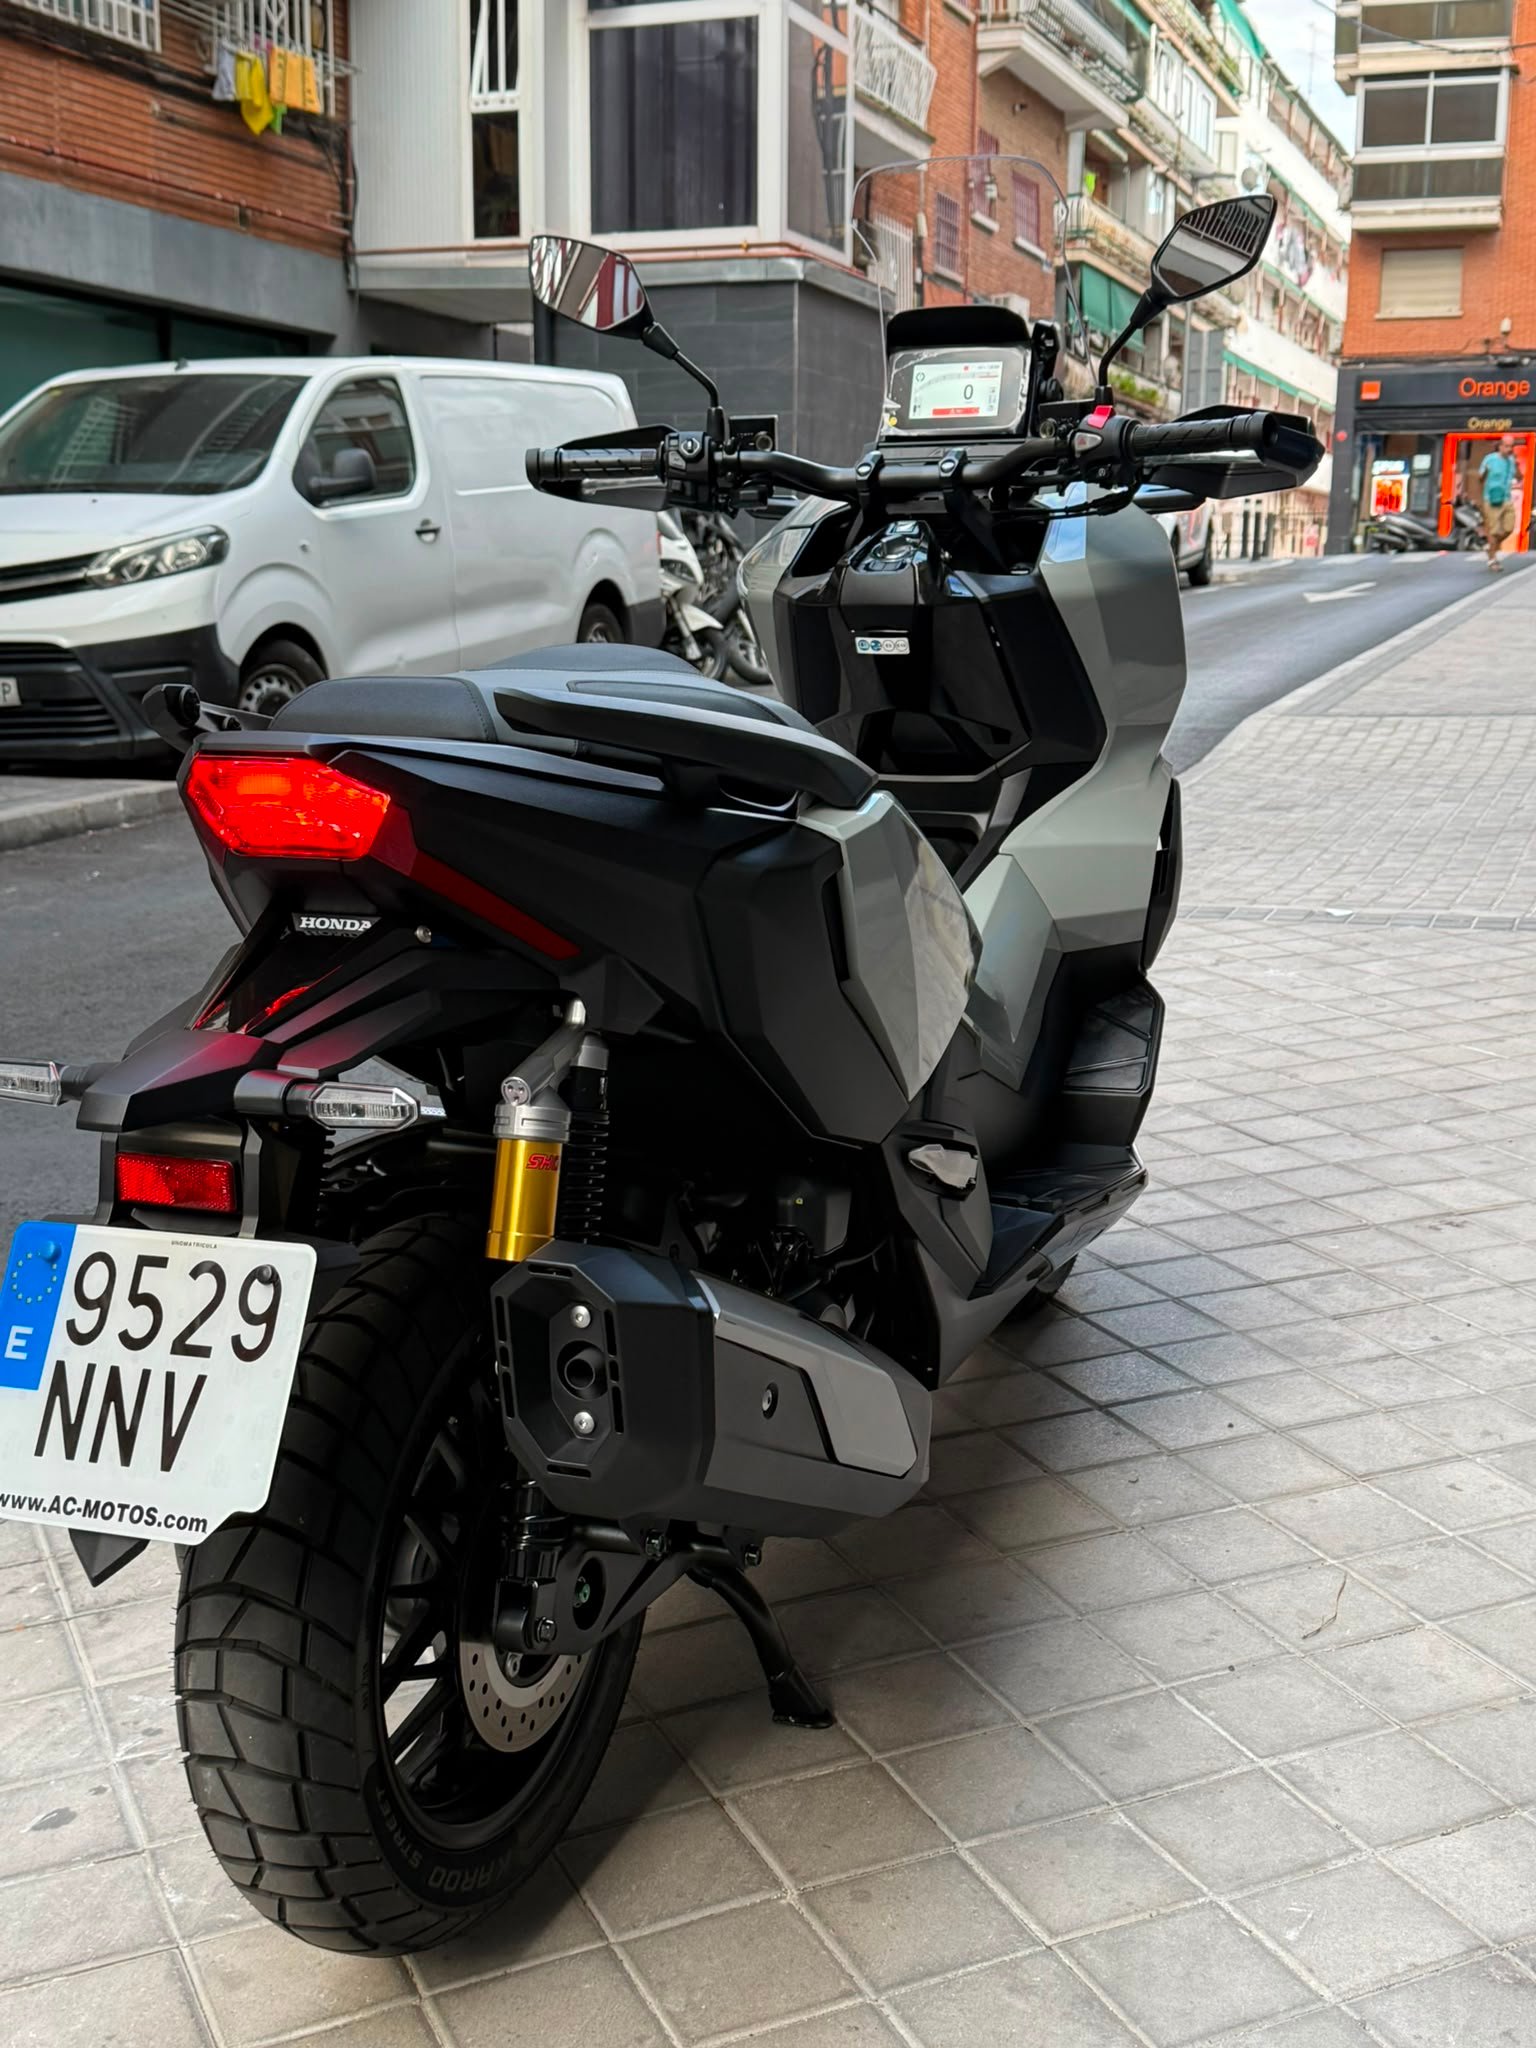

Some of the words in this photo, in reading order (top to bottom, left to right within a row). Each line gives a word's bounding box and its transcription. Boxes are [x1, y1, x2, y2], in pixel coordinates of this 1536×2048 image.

[963, 384, 974, 400] 0
[1458, 377, 1530, 401] Orange
[1467, 417, 1513, 431] Orange
[299, 916, 372, 932] HONDA
[66, 1251, 283, 1362] 9529
[4, 1325, 34, 1360] E
[34, 1360, 208, 1472] NNV
[0, 1493, 208, 1534] www.AC-MOTOS.com
